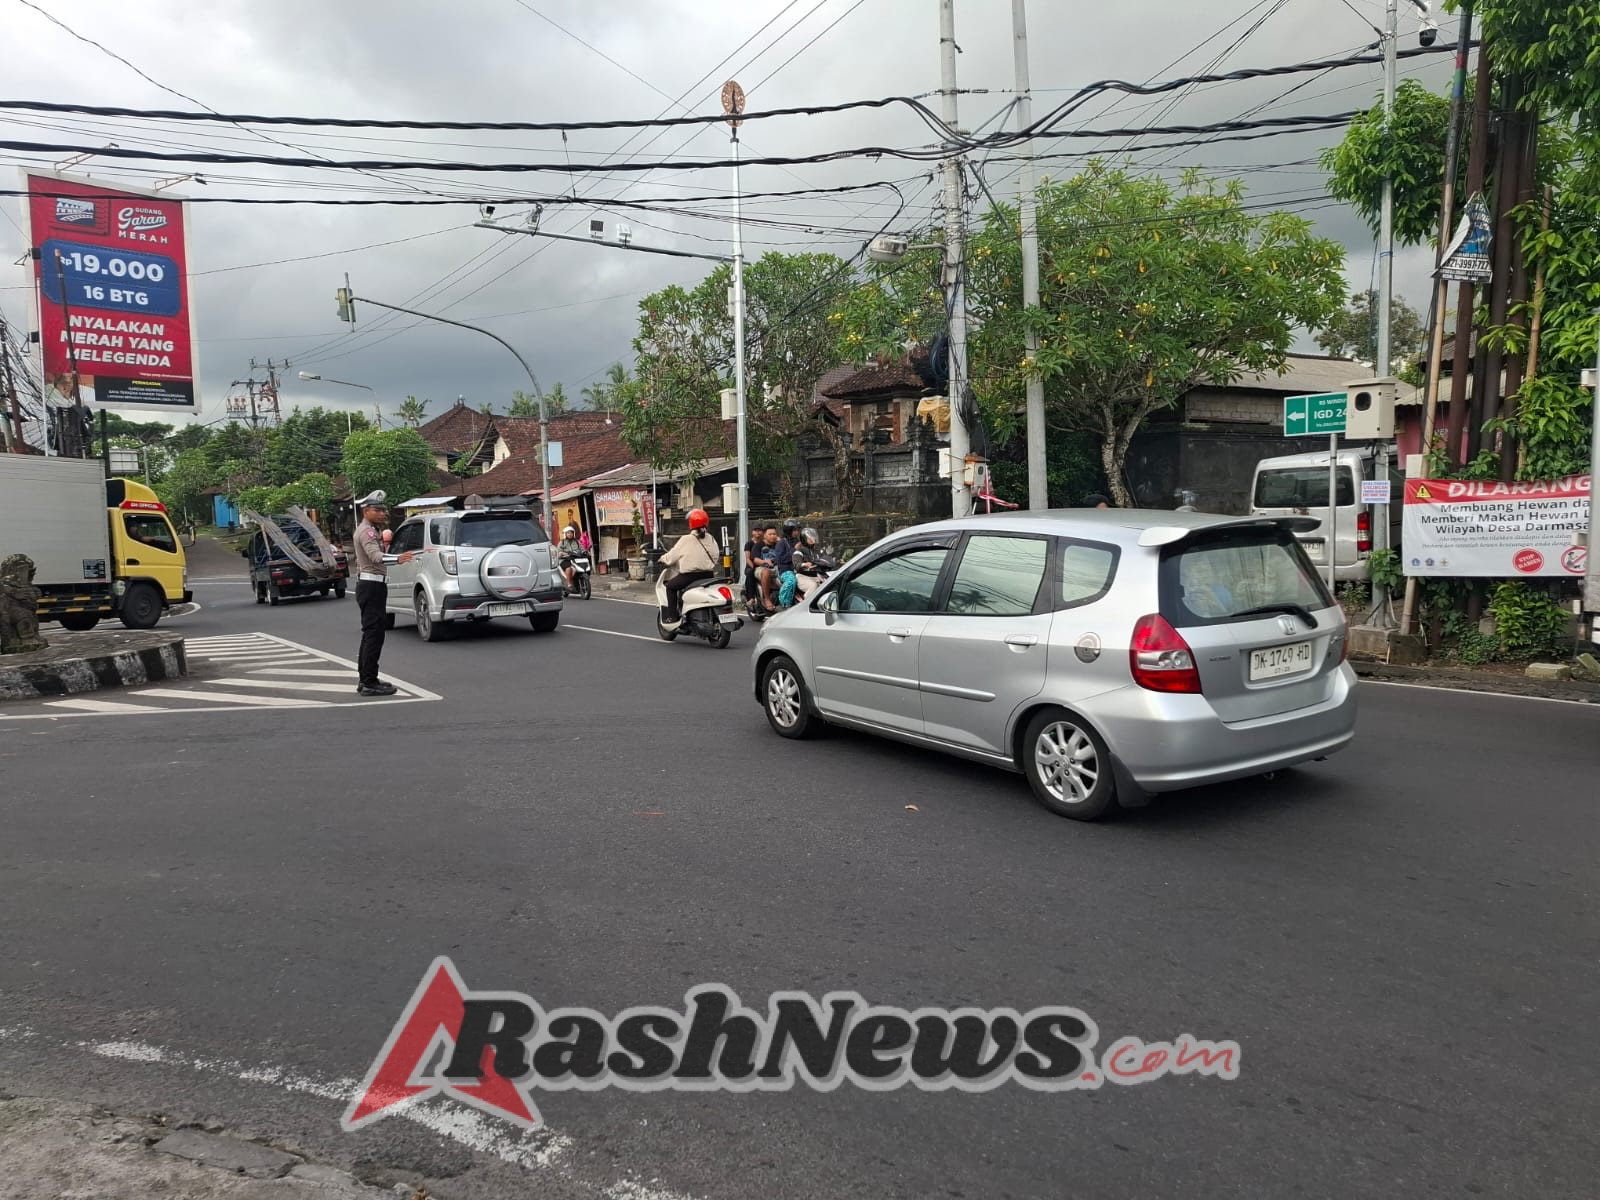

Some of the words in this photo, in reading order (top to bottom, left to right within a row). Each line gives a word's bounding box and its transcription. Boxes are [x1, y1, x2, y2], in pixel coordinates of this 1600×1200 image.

[118, 207, 168, 230] Garam
[135, 207, 162, 215] GUDANG
[119, 230, 168, 244] MERAH
[83, 285, 105, 300] 16
[110, 288, 149, 305] BTG
[69, 315, 165, 335] NYALAKAN
[60, 330, 123, 347] MERAH
[129, 336, 174, 352] YANG
[66, 347, 171, 367] MELEGENDA
[1314, 409, 1333, 420] IGD
[1448, 475, 1591, 497] DILARANG
[1441, 503, 1513, 513] Membuang
[1518, 500, 1568, 510] Hewan
[1573, 498, 1590, 508] da
[1421, 514, 1474, 524] Memberi
[1478, 512, 1524, 522] Makan
[1529, 510, 1578, 521] Hewan
[1436, 523, 1484, 535] Wilayah
[1488, 523, 1520, 533] Desa
[1525, 520, 1590, 531] Darmasa
[1254, 652, 1266, 670] DK
[1298, 645, 1309, 661] HD
